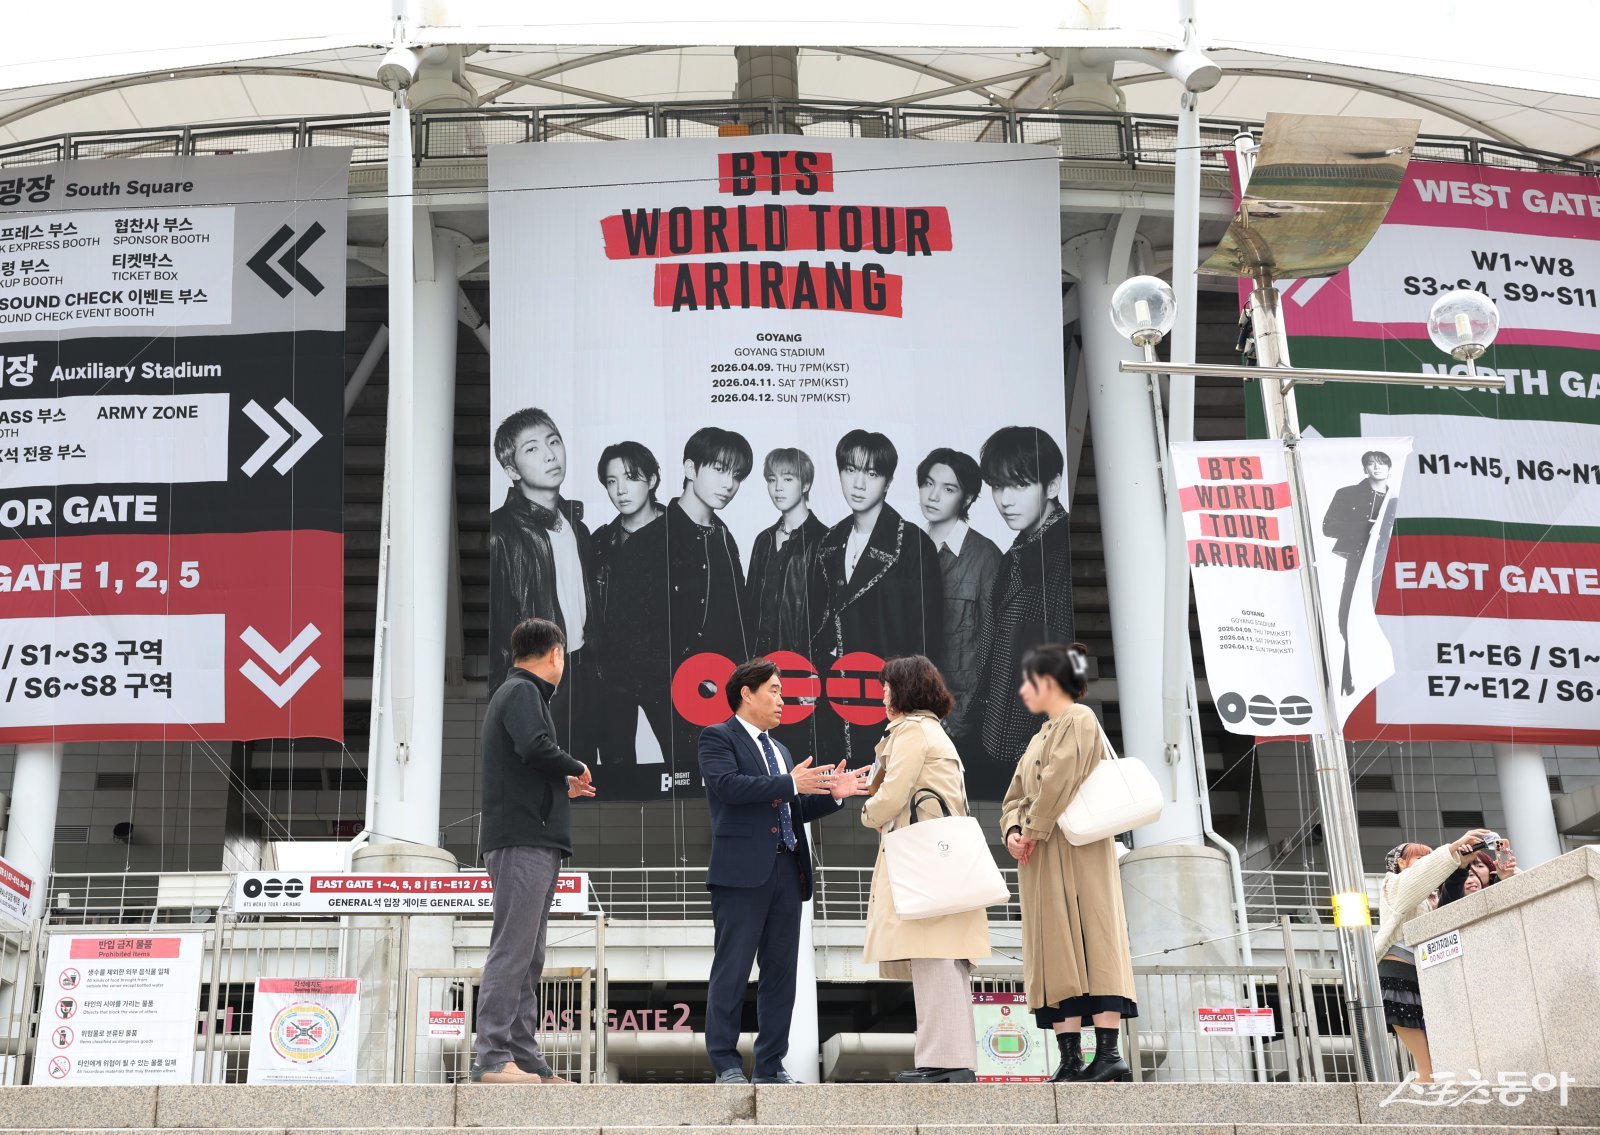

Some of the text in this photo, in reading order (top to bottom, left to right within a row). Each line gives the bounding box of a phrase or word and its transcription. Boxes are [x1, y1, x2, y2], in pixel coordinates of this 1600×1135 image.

[732, 150, 819, 197] BTS
[0, 174, 194, 206] 광장 South Square
[1413, 178, 1511, 209] WEST
[1, 222, 78, 241] 프레스 부스
[114, 217, 193, 234] 협찬사 부스
[621, 204, 932, 257] WORLD TOUR
[9, 241, 60, 253] EXPRESS
[62, 237, 100, 249] BOOTH
[113, 234, 210, 245] SPONSOR BOOTH
[0, 259, 50, 277] 령 부스
[112, 252, 173, 269] 티켓박스
[1470, 250, 1575, 277] W1~W8
[23, 276, 63, 287] BOOTH
[112, 271, 179, 281] TICKET BOX
[671, 260, 887, 312] ARIRANG
[0, 289, 208, 310] SOUND CHECK 이벤트 부스
[35, 310, 73, 321] CHECK
[76, 308, 111, 319] EVENT
[114, 307, 155, 317] BOOTH
[756, 333, 802, 342] GOYANG
[734, 347, 825, 357] GOYANG STADIUM
[0, 353, 222, 388] 장 Auxiliary Stadium
[710, 362, 850, 373] 2026.04.09. THU 7PM(KST)
[712, 378, 849, 388] 2026.04.11. SAT 7PM(KST)
[710, 393, 851, 403] 2026.04.12. SUN 7PM(KST)
[37, 408, 67, 424] 부스
[97, 405, 199, 420] ARMY ZONE
[23, 445, 53, 463] 전용
[57, 444, 87, 460] 부스
[1207, 457, 1253, 481] BTS
[1418, 454, 1511, 485] N1~N5,
[1194, 484, 1275, 511] WORLD
[0, 494, 158, 528] OR GATE
[1208, 514, 1270, 541] TOUR
[1195, 542, 1295, 571] ARIRANG
[95, 561, 124, 595] 1,
[135, 560, 168, 595] 2,
[179, 561, 200, 589] 5
[1394, 561, 1600, 596] EAST GATE
[1230, 617, 1254, 625] GOYANG
[1241, 609, 1265, 618] GOYANG
[1, 638, 163, 670] / S1~S3 구역
[1437, 642, 1522, 667] E1~E6
[1530, 645, 1541, 670] /
[5, 671, 172, 703] / S6~S8 구역
[1427, 675, 1600, 703] E7~E12 / S6
[674, 771, 690, 779] BIGHIT
[316, 879, 343, 889] EAST
[346, 879, 373, 889] GATE
[376, 880, 400, 891] 1~4,
[402, 880, 412, 891] 5,
[414, 880, 421, 889] 8
[430, 880, 471, 889] E1~E12
[383, 898, 400, 907] 입장
[402, 897, 428, 907] 게이트
[430, 898, 475, 907] GENERAL
[98, 939, 153, 950] 반입 금지 물품
[1430, 946, 1459, 963] DO NOT CLIMB
[606, 1008, 668, 1031] GATE
[672, 1002, 692, 1031] 2
